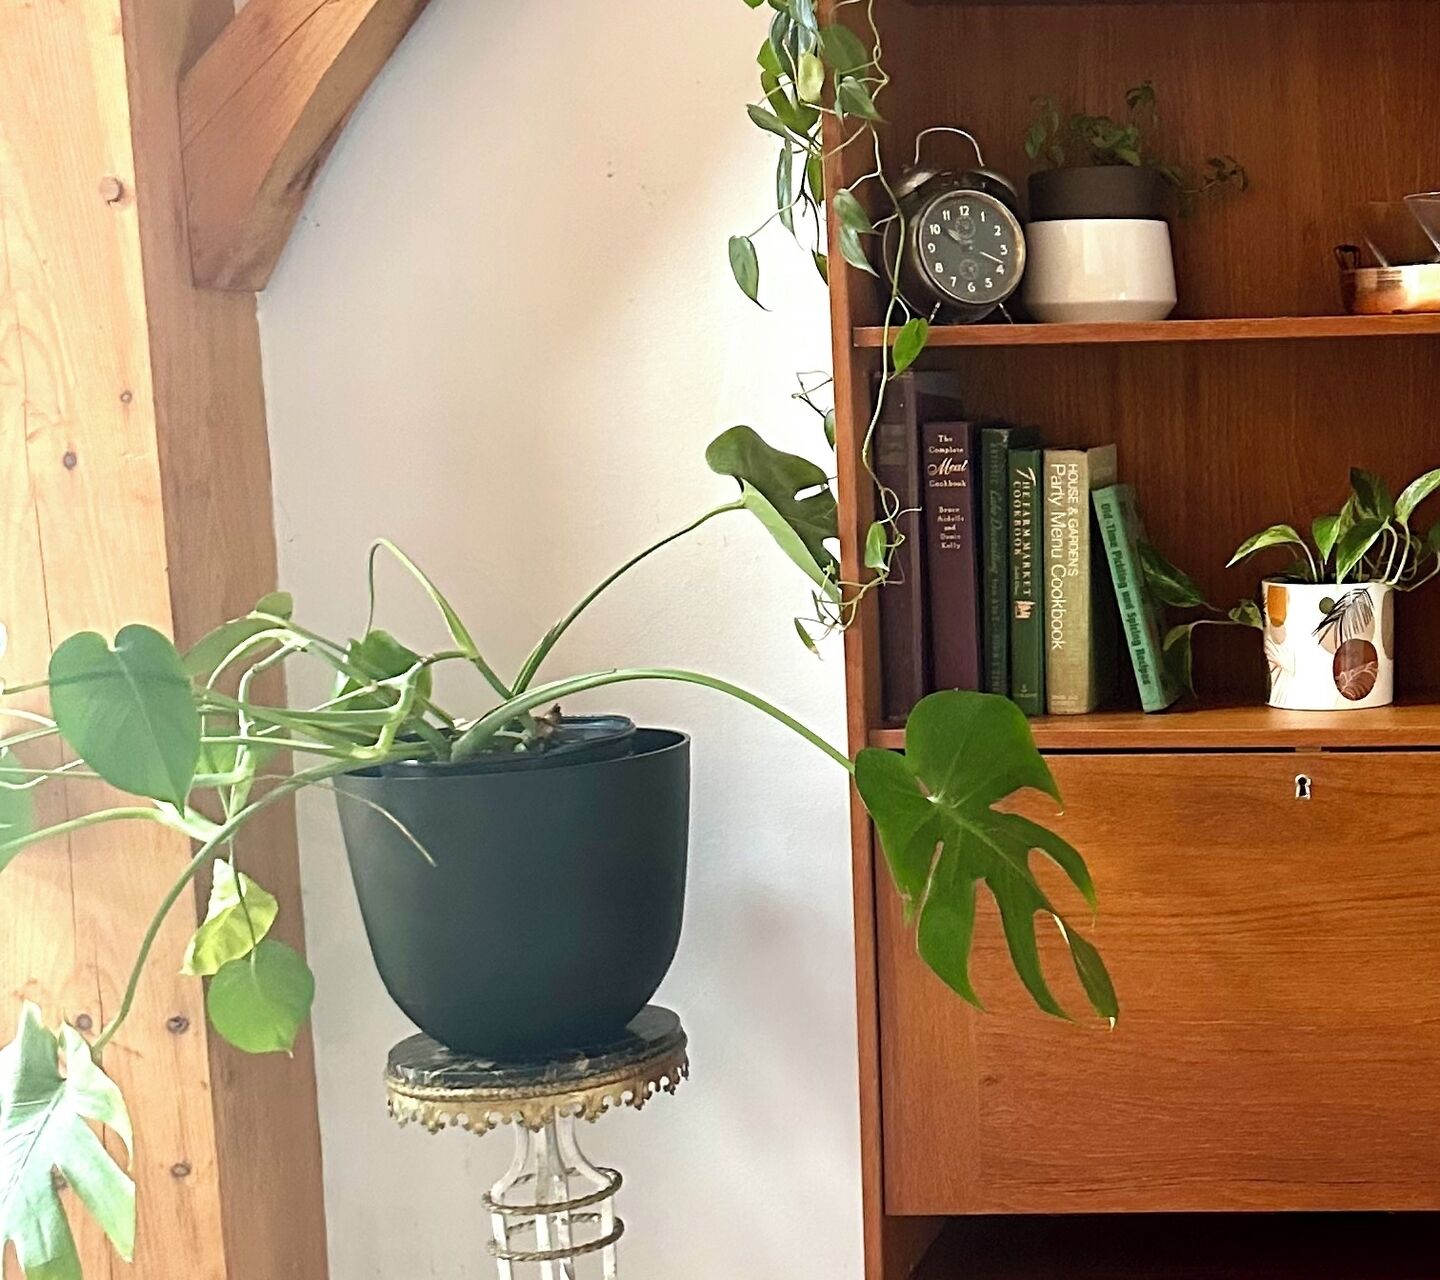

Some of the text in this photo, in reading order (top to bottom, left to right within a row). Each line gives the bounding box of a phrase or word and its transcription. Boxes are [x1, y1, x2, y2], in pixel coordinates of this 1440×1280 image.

[942, 210, 951, 221] 11
[959, 205, 970, 216] 12
[980, 211, 986, 222] 1
[929, 224, 941, 235] 10
[993, 225, 1001, 236] 2
[927, 242, 936, 253] 9
[1000, 245, 1008, 255] 3
[934, 262, 944, 273] 8
[996, 264, 1005, 274] 4
[950, 276, 957, 287] 7
[967, 281, 976, 292] 6
[985, 277, 993, 288] 5
[929, 446, 964, 454] Complete
[927, 457, 969, 476] Meat
[1068, 463, 1078, 504] HOUSE
[1068, 507, 1078, 516] &
[1013, 481, 1022, 556] COOKBOOK
[1016, 467, 1036, 597] THE FARM MARKET
[1048, 463, 1067, 650] Party Menu Cookbook
[1112, 551, 1128, 589] Pickling
[1122, 591, 1134, 610] and
[1125, 612, 1142, 646] Spicing
[1135, 648, 1151, 685] Recipes
